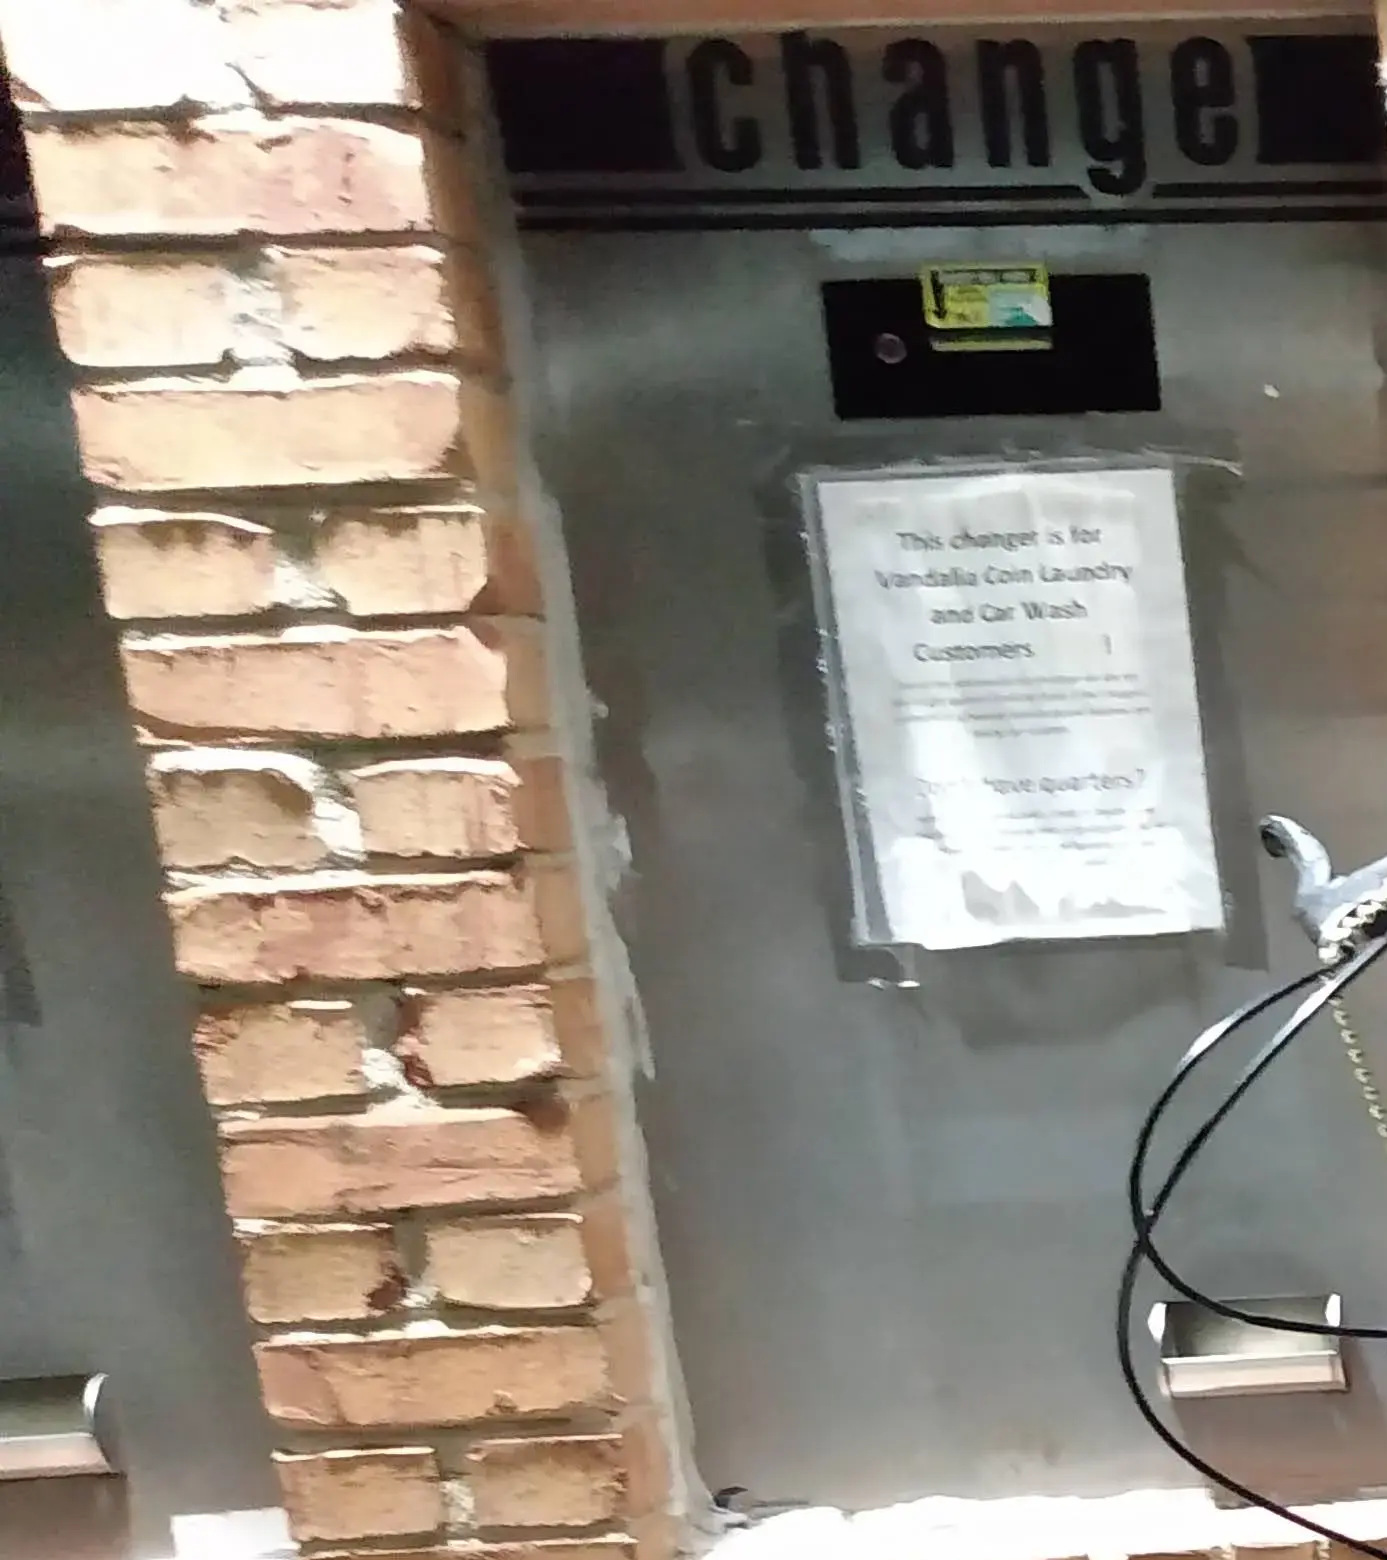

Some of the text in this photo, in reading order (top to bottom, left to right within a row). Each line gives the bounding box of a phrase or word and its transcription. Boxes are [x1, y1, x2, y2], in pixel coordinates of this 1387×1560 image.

[685, 31, 1238, 196] change
[895, 525, 1101, 552] This changer is for
[874, 560, 1134, 590] Vandalia Coin Laundry
[930, 599, 1088, 624] and Car Wash
[913, 642, 1036, 662] Customers
